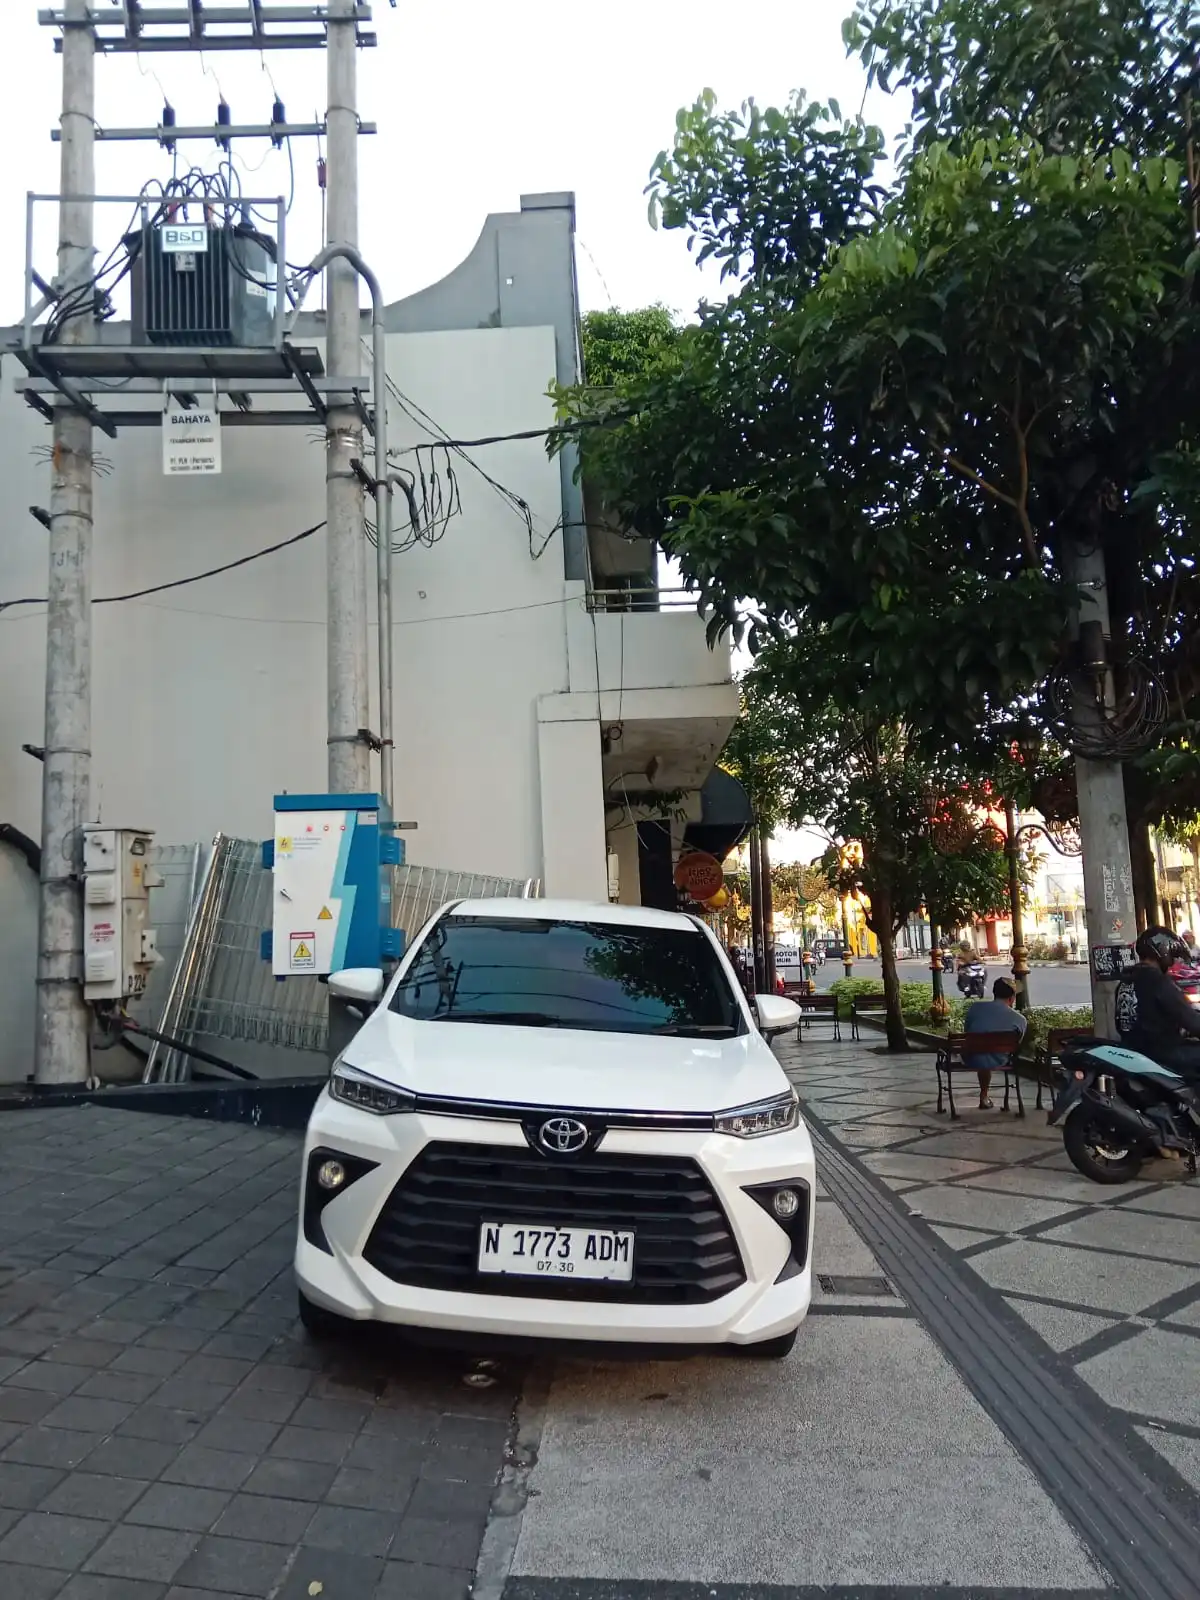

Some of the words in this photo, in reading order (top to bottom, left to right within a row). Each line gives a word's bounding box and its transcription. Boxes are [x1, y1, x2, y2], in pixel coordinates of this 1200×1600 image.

[171, 415, 211, 424] BAHAYA
[485, 1228, 500, 1254] N
[512, 1230, 572, 1258] 1773
[584, 1234, 629, 1262] ADM
